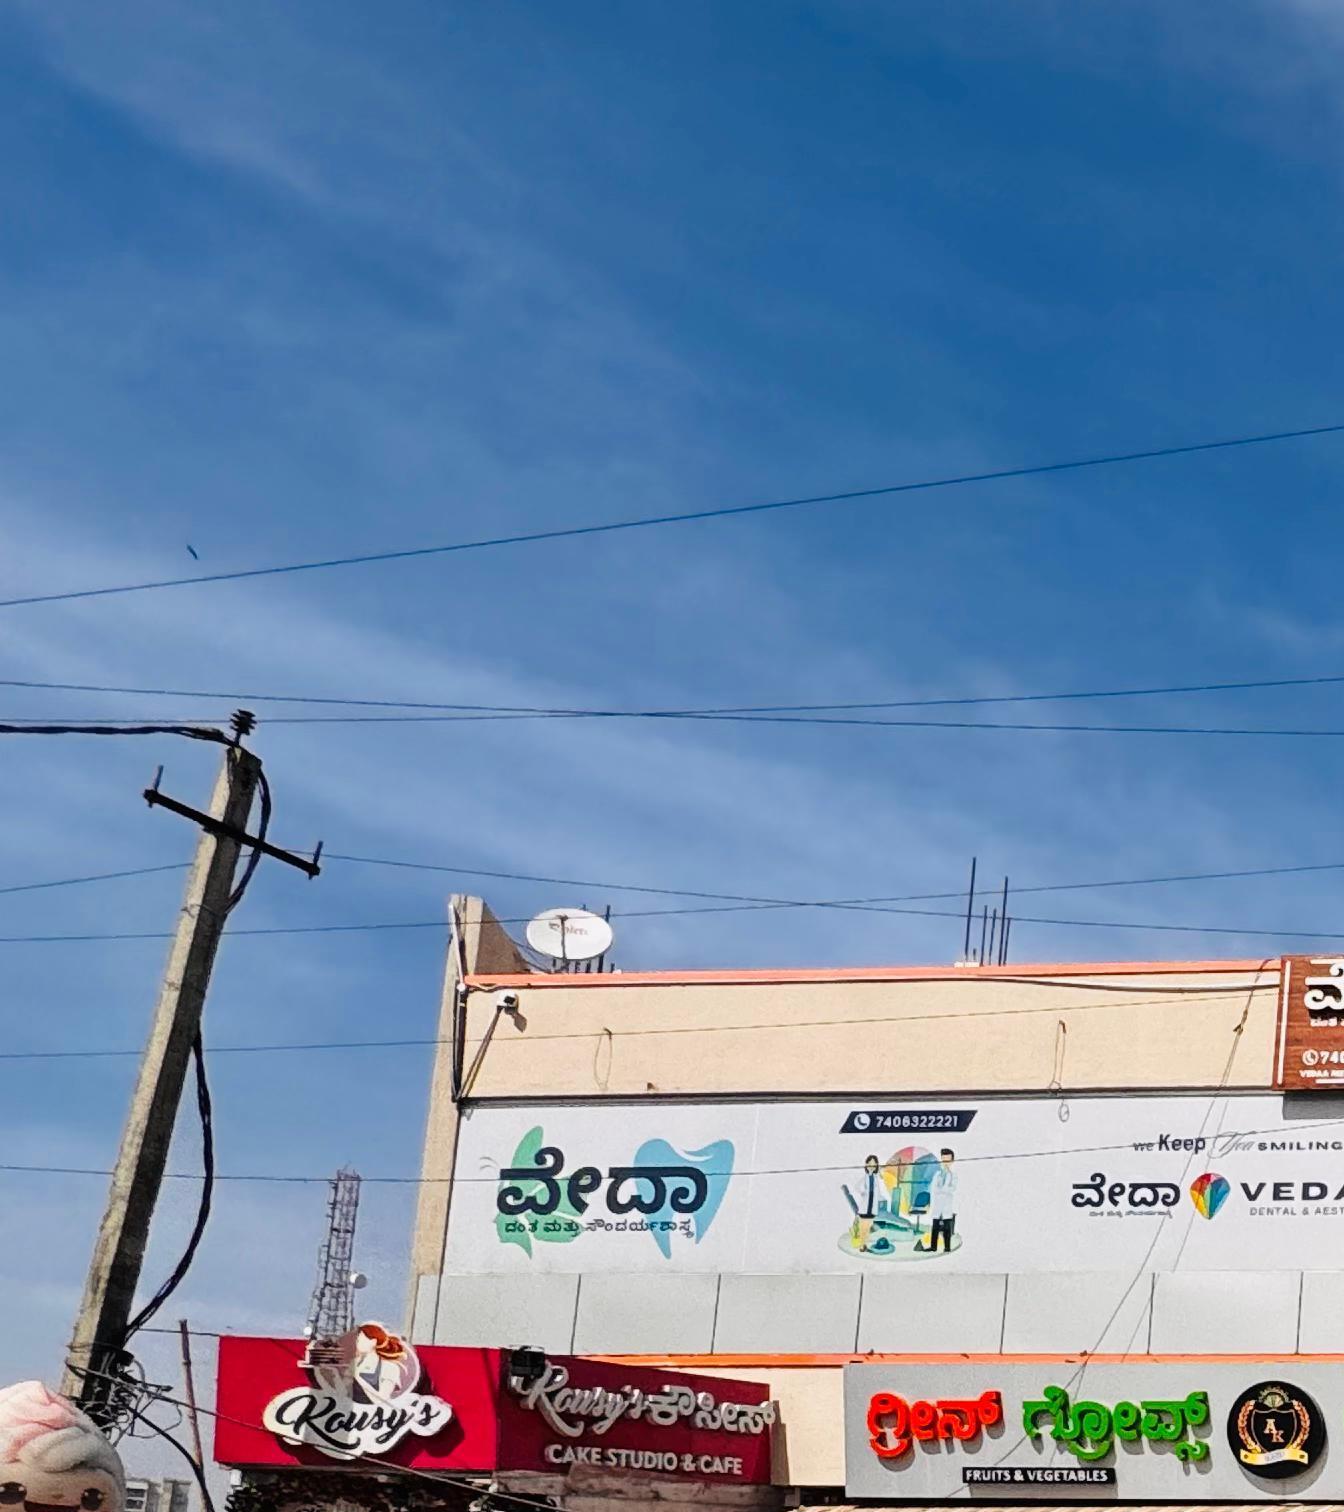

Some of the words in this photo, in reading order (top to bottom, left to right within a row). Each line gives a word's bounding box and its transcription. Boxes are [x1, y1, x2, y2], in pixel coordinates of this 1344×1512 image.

[875, 1115, 958, 1128] 7406322221
[1158, 1133, 1206, 1155] Keep
[1258, 1141, 1344, 1151] SMILING
[497, 1146, 707, 1215] ವೇದಾ
[1071, 1172, 1181, 1208] ವೇದಾ
[1249, 1206, 1297, 1216] DENTAL
[1302, 1206, 1309, 1216] &
[504, 1220, 537, 1233] ದಂತ
[543, 1219, 581, 1237] ಮತ್ತು
[275, 1394, 440, 1449] Kousy's
[867, 1391, 1002, 1458] ಗ್ರೀನ್
[547, 1442, 602, 1464] CAKE
[607, 1447, 678, 1471] STUDIO
[681, 1453, 696, 1472] &
[698, 1454, 744, 1475] CAFE
[965, 1468, 1011, 1482] FRUITS
[1013, 1469, 1023, 1482] &
[1027, 1469, 1108, 1482] VEGETABLES
